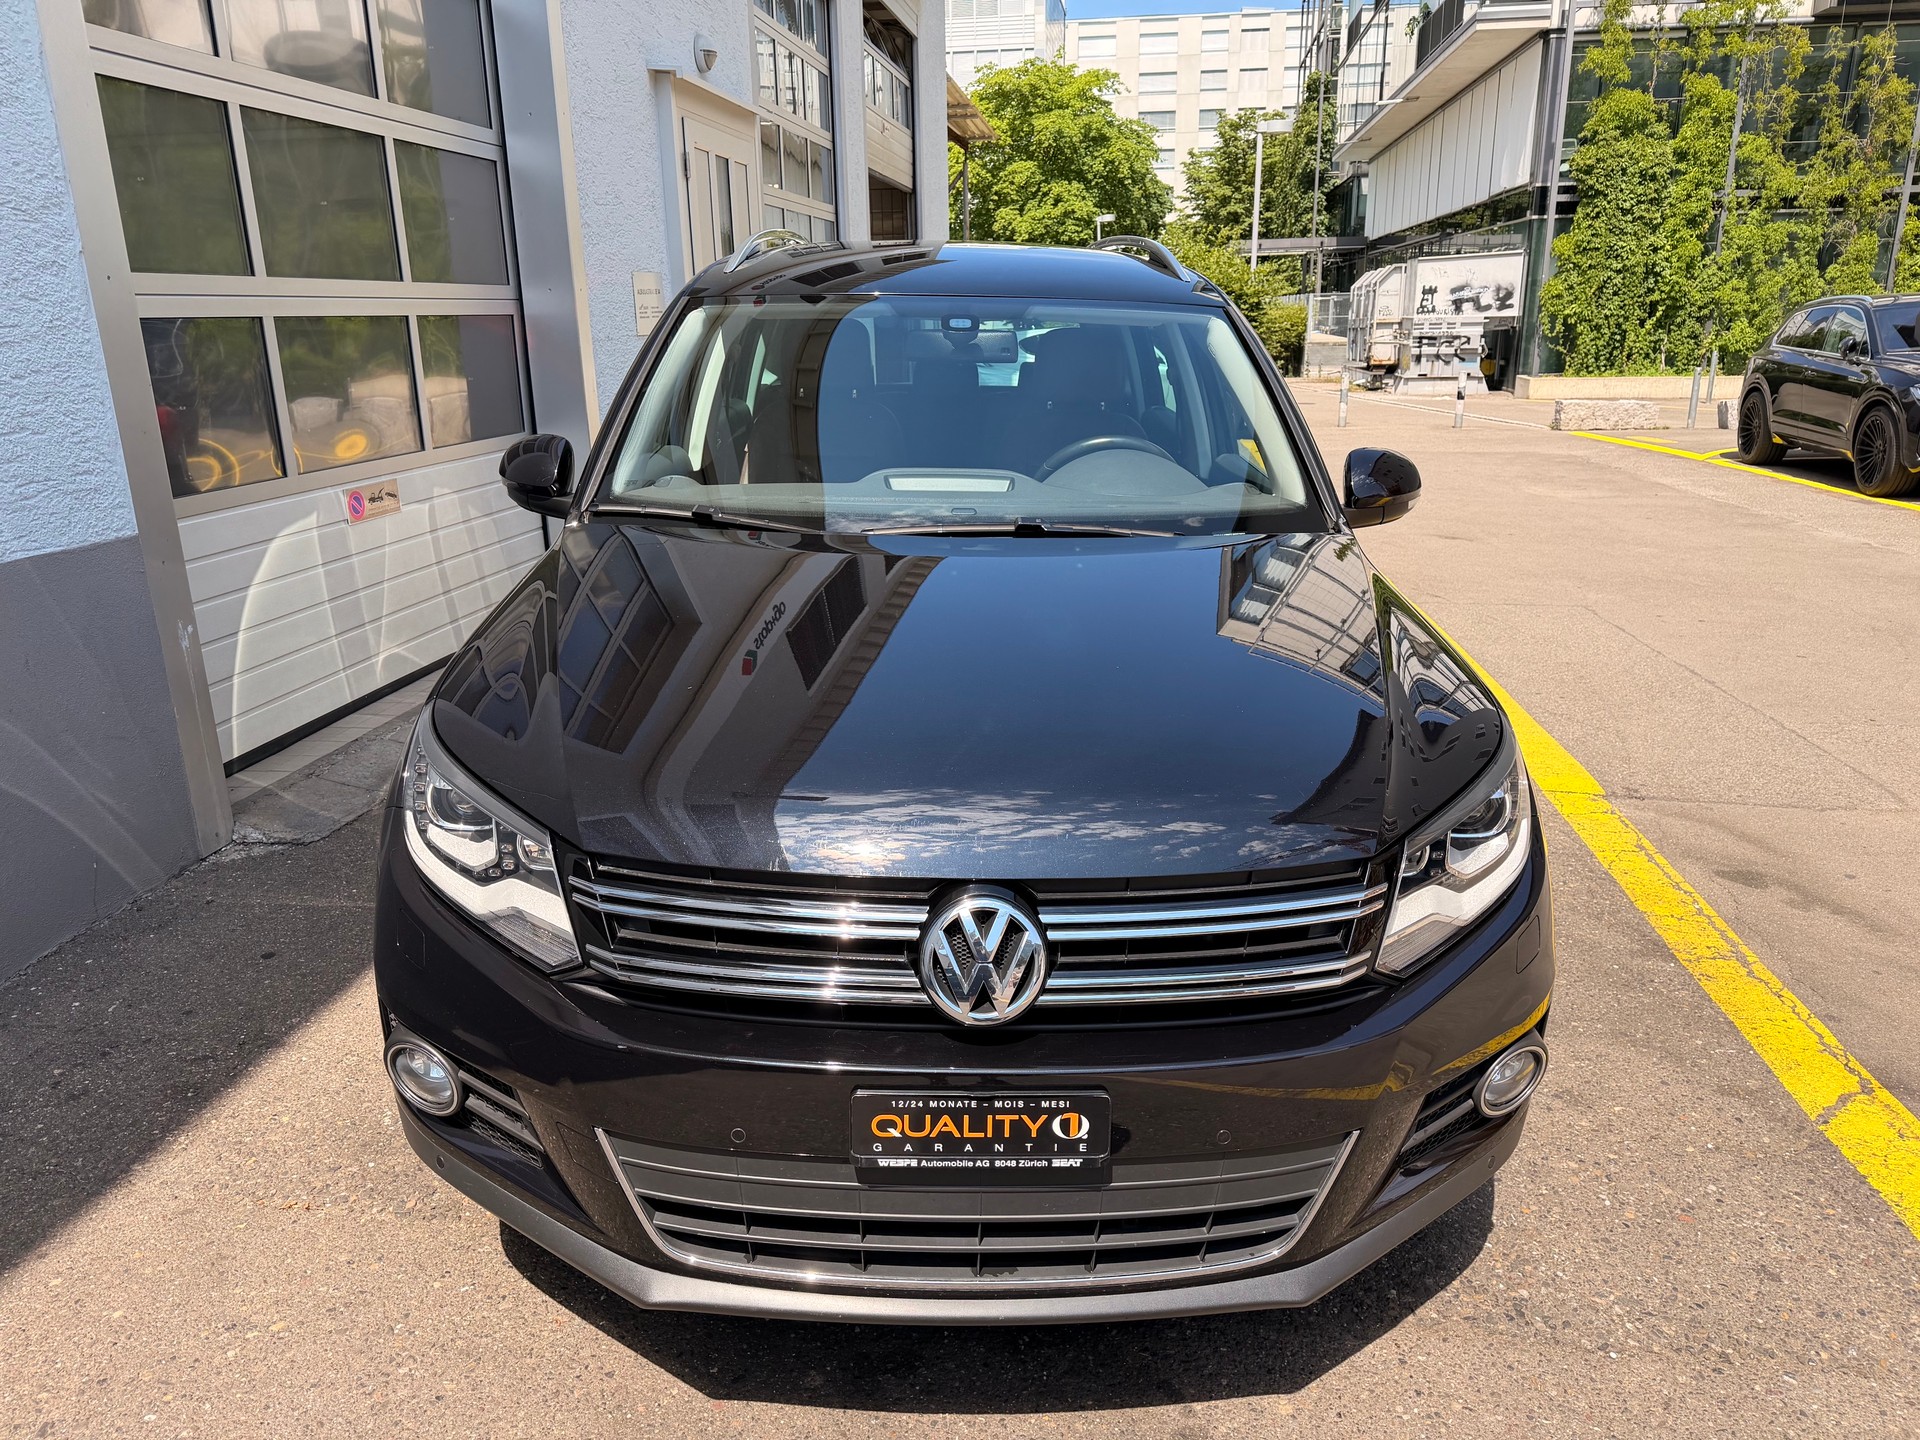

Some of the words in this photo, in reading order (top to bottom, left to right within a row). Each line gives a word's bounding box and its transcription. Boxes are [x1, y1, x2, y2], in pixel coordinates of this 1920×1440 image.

[891, 1100, 924, 1108] 12/24
[929, 1100, 978, 1108] MONATE
[994, 1100, 1025, 1108] MOIS
[1041, 1100, 1070, 1108] MESI
[871, 1114, 1049, 1138] QUALITY
[872, 1143, 1087, 1152] GARANTIE
[920, 1159, 974, 1167] Automobile
[975, 1159, 990, 1167] AG
[994, 1159, 1017, 1167] 8048
[1018, 1159, 1048, 1167] Zürich
[1051, 1158, 1083, 1167] SEAT
